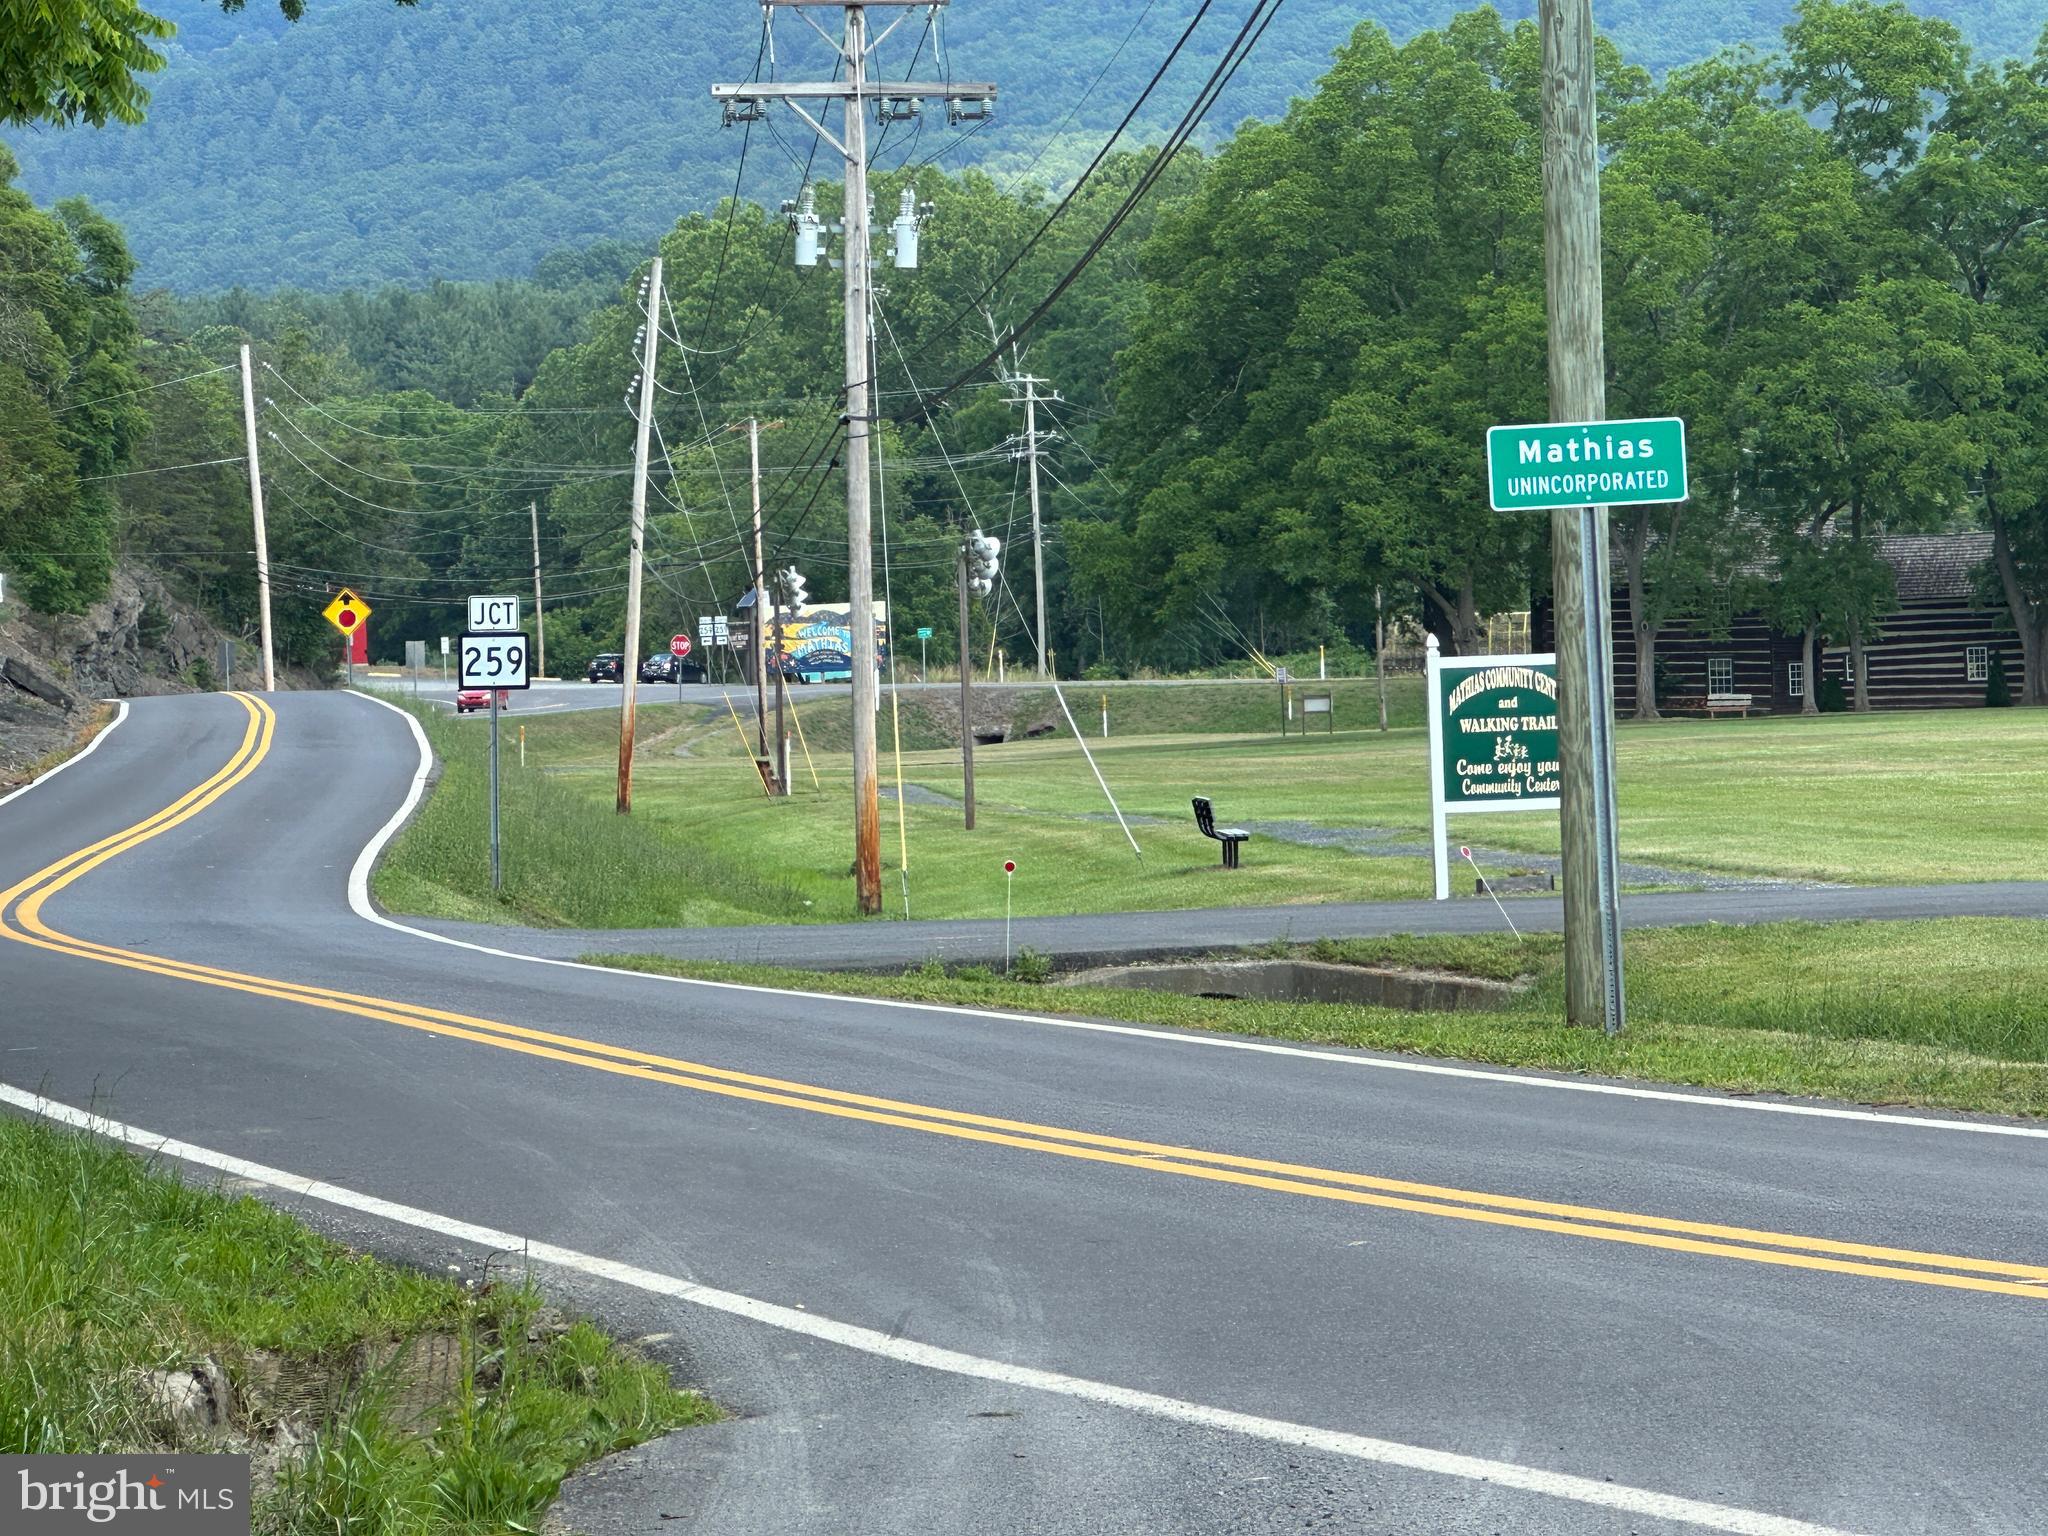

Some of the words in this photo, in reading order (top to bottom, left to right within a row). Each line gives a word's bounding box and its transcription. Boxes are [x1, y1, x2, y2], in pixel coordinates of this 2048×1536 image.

[1519, 435, 1654, 464] Mathias
[1507, 470, 1669, 497] UNINCORPORATED
[474, 602, 514, 625] JCT
[799, 626, 840, 638] WELCOME
[671, 641, 690, 650] STOP
[797, 639, 849, 655] MATHIAS
[465, 646, 523, 677] 259
[1449, 671, 1485, 716] MATHIAS
[1485, 666, 1533, 690] COMMUNITY
[1498, 696, 1518, 708] and
[1460, 718, 1519, 733] WALKING
[1456, 759, 1493, 776] Come
[1497, 760, 1531, 777] enjoy
[1462, 778, 1522, 797] Community
